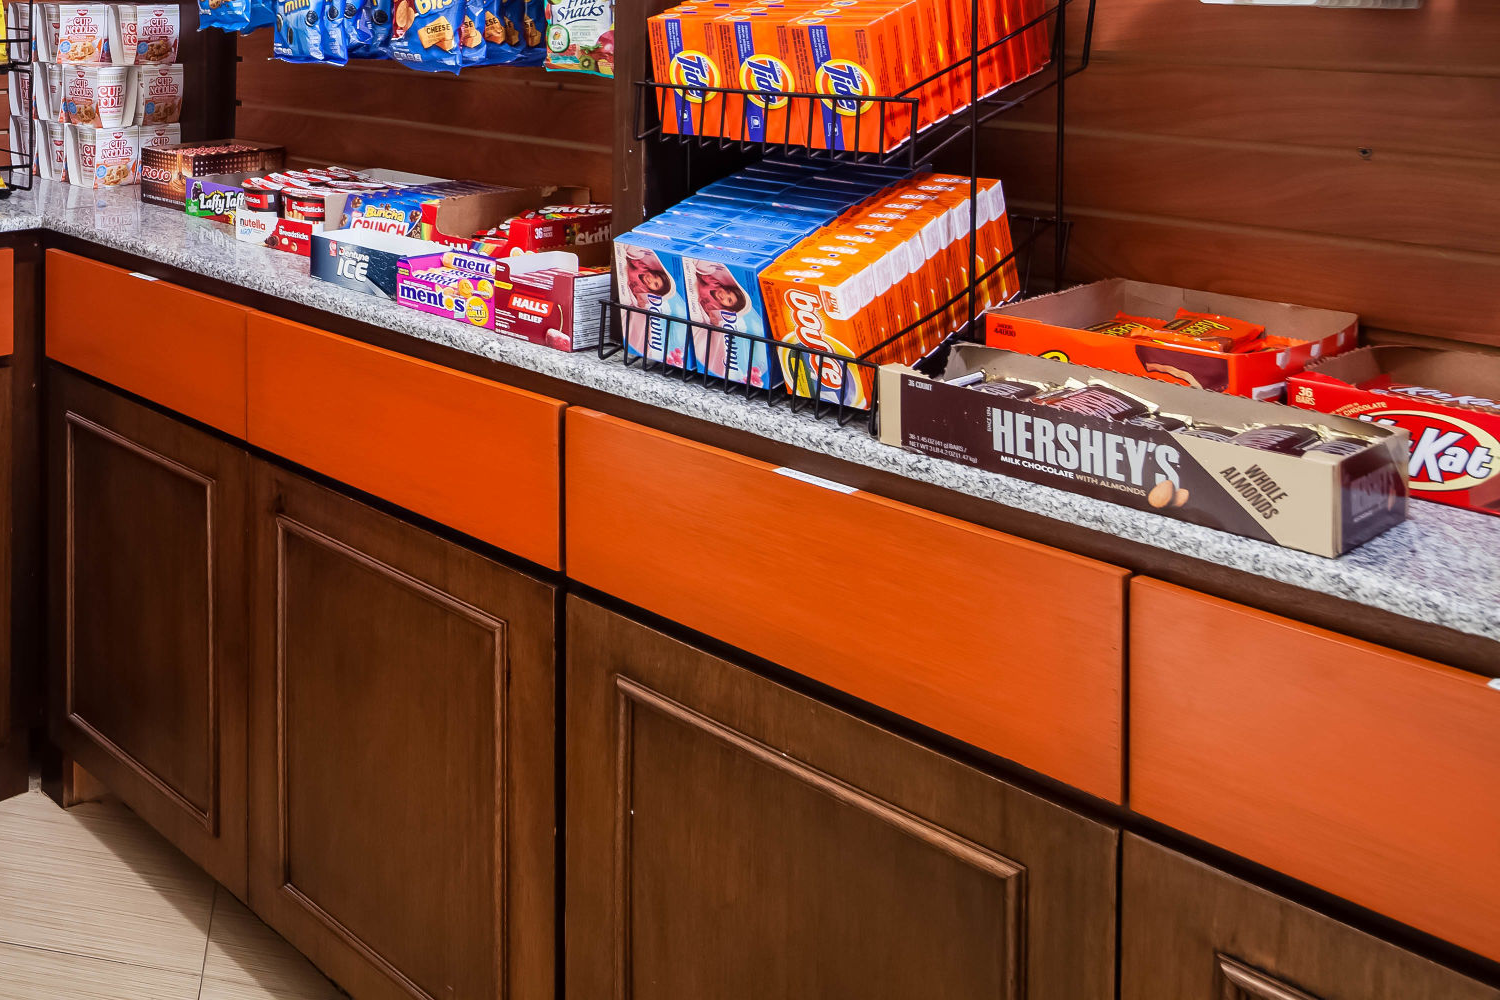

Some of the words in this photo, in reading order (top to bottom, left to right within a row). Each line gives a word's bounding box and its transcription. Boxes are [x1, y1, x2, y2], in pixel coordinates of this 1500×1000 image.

[557, 4, 605, 23] Snacks
[73, 17, 92, 27] CUP
[150, 18, 168, 27] CUP
[426, 24, 451, 35] CHEESE
[65, 25, 98, 35] NOODLES
[74, 79, 88, 88] CUP
[155, 77, 172, 86] CUP
[98, 86, 122, 97] CUP
[109, 140, 127, 149] CUP
[141, 165, 172, 182] Rolo
[199, 192, 226, 215] Laffy
[365, 205, 405, 222] Buncha
[239, 217, 266, 232] nutella
[278, 227, 310, 241] Breadsticks
[534, 227, 543, 239] 36
[338, 247, 370, 263] Dentyne
[336, 257, 369, 282] ICE
[400, 284, 466, 313] mentos
[512, 296, 549, 313] HALLS
[518, 313, 543, 324] RELIEF
[646, 293, 663, 354] Downy
[721, 311, 739, 373] Downy
[915, 381, 933, 391] COUNT
[1298, 386, 1313, 397] 36
[1295, 395, 1316, 406] BARS
[992, 407, 1181, 492] HERSHEY'S
[1000, 455, 1021, 467] MILK
[1021, 458, 1074, 480] CHOCOLATE
[1075, 474, 1099, 487] WITH
[1099, 479, 1147, 497] ALMONDS
[1244, 464, 1288, 504] WHOLE
[1219, 466, 1280, 520] ALMONDS
